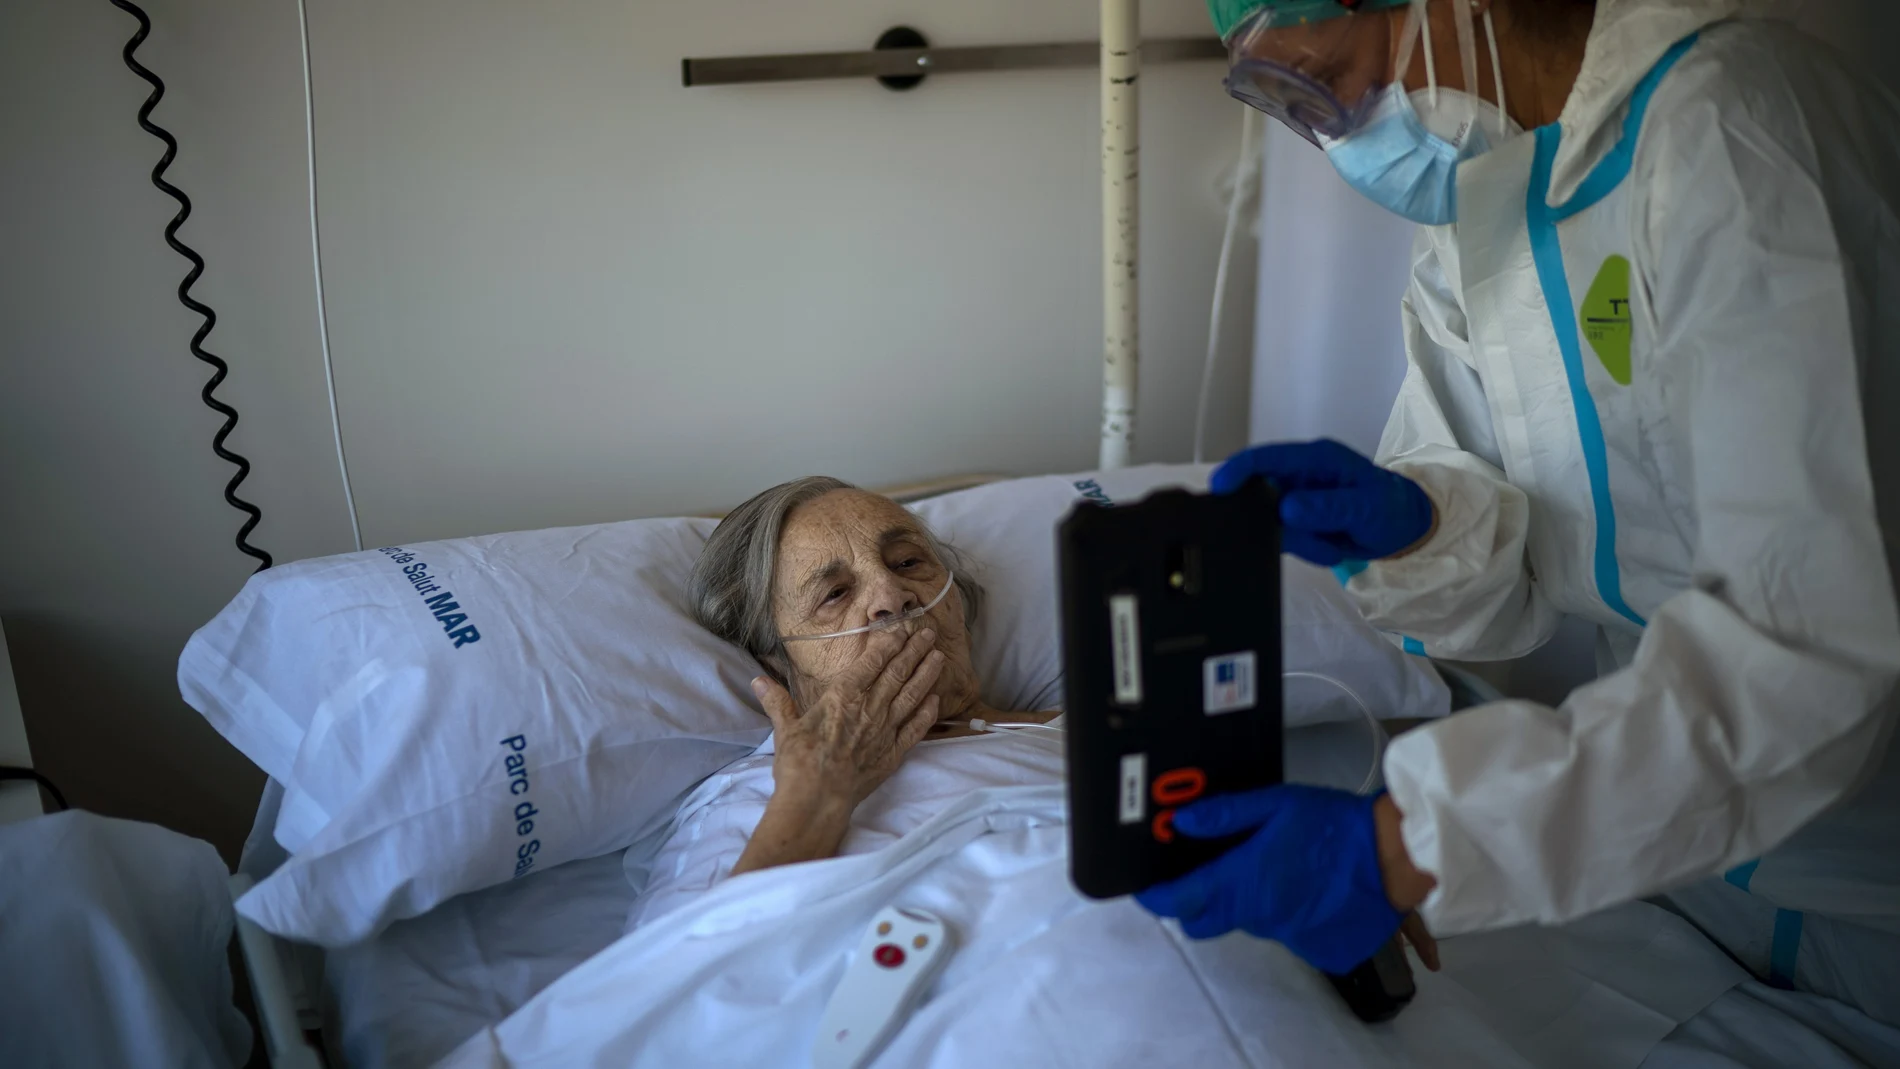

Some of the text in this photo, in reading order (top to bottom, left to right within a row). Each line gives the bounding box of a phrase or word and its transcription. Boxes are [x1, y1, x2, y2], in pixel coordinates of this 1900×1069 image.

[390, 552, 416, 564] de
[402, 562, 441, 596] Salut
[424, 591, 481, 649] MAR
[499, 734, 528, 796] Parc
[514, 802, 539, 836] de
